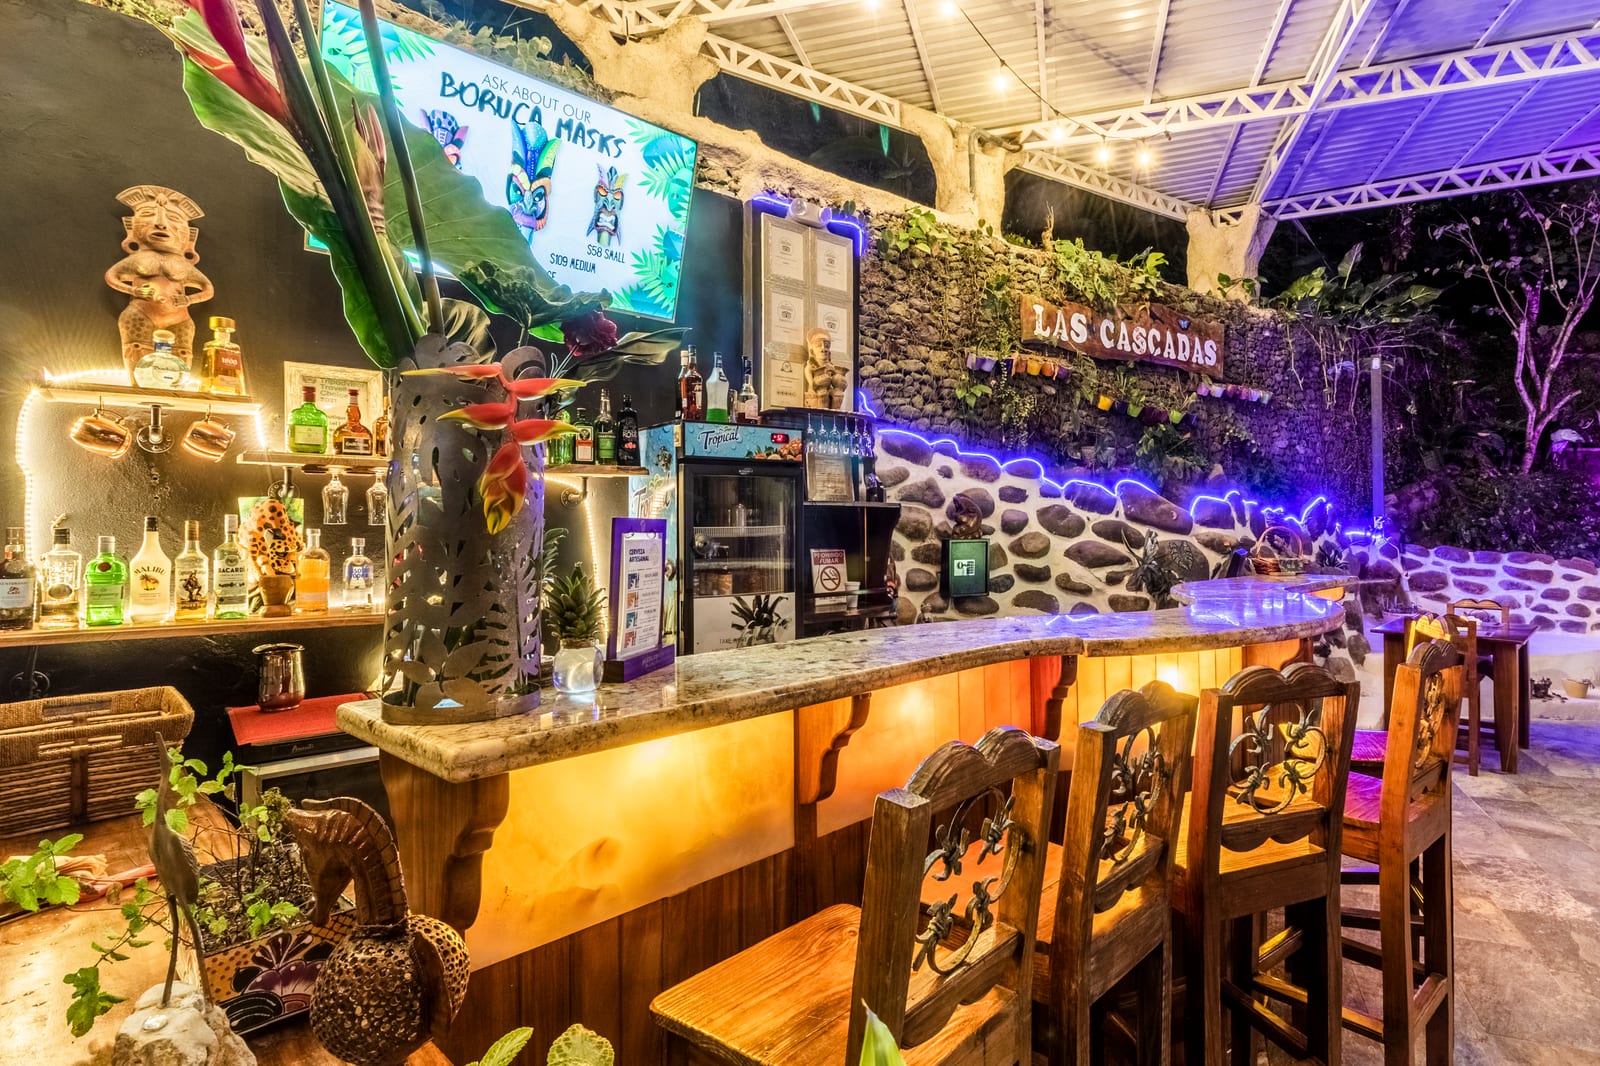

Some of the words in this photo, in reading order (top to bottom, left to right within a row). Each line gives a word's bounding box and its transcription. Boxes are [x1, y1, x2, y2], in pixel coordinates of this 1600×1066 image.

[481, 73, 509, 94] ASK
[512, 85, 560, 111] ABOUT
[562, 103, 592, 124] OUR
[439, 71, 543, 126] BORUCA
[555, 117, 627, 159] MASKS
[569, 257, 597, 274] MEDIUM
[603, 248, 625, 264] SMALL
[1032, 303, 1088, 344] LAS
[1099, 318, 1218, 367] CASCADAS
[698, 425, 740, 450] Tropical
[133, 565, 166, 575] MALIBU
